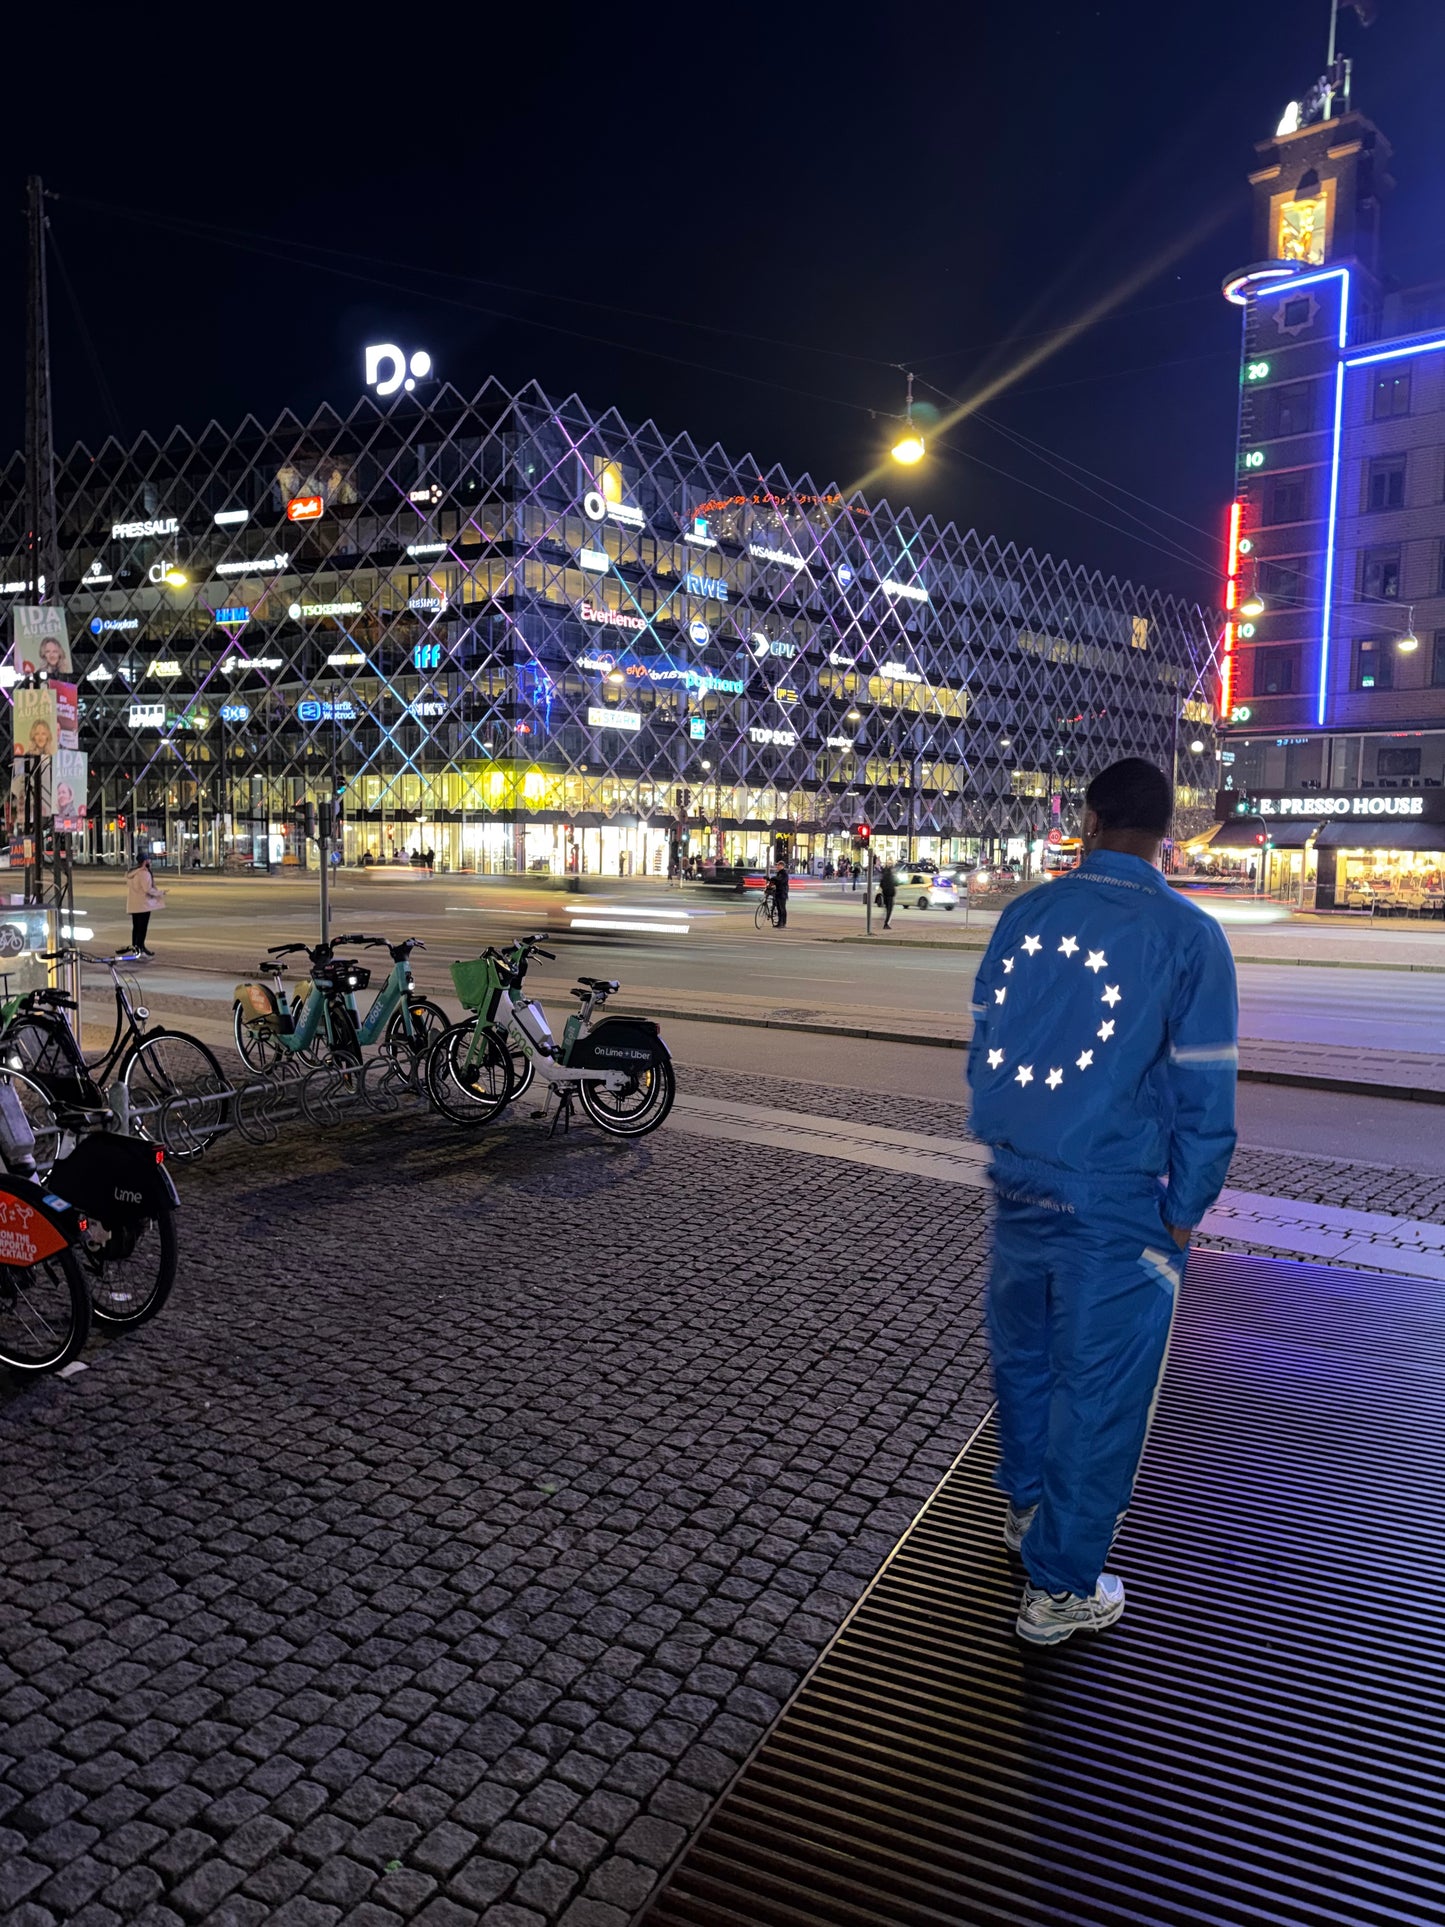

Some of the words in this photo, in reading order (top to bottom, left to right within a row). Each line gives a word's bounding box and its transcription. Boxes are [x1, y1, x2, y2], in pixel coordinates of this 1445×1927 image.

[1248, 362, 1269, 380] 20
[1246, 452, 1263, 467] 10
[112, 518, 178, 539] PRESSALIT
[1239, 540, 1251, 554] 0
[686, 575, 728, 601] RWE
[20, 607, 60, 625] IDA
[24, 622, 61, 635] AUKEN
[1237, 624, 1254, 638] 10
[415, 644, 440, 668] iff
[18, 691, 52, 709] IDA
[19, 705, 53, 718] AUKEN
[1231, 707, 1250, 722] 20
[603, 712, 637, 727] STARK
[56, 751, 83, 768] IDA
[57, 768, 84, 777] AUKEN
[1353, 797, 1423, 814] HOUSE
[594, 1047, 604, 1056] On
[606, 1048, 623, 1057] Lime
[631, 1050, 650, 1060] Uber
[15, 1232, 29, 1243] THE
[0, 1248, 33, 1262] CKTAILS
[26, 1244, 37, 1253] TO
